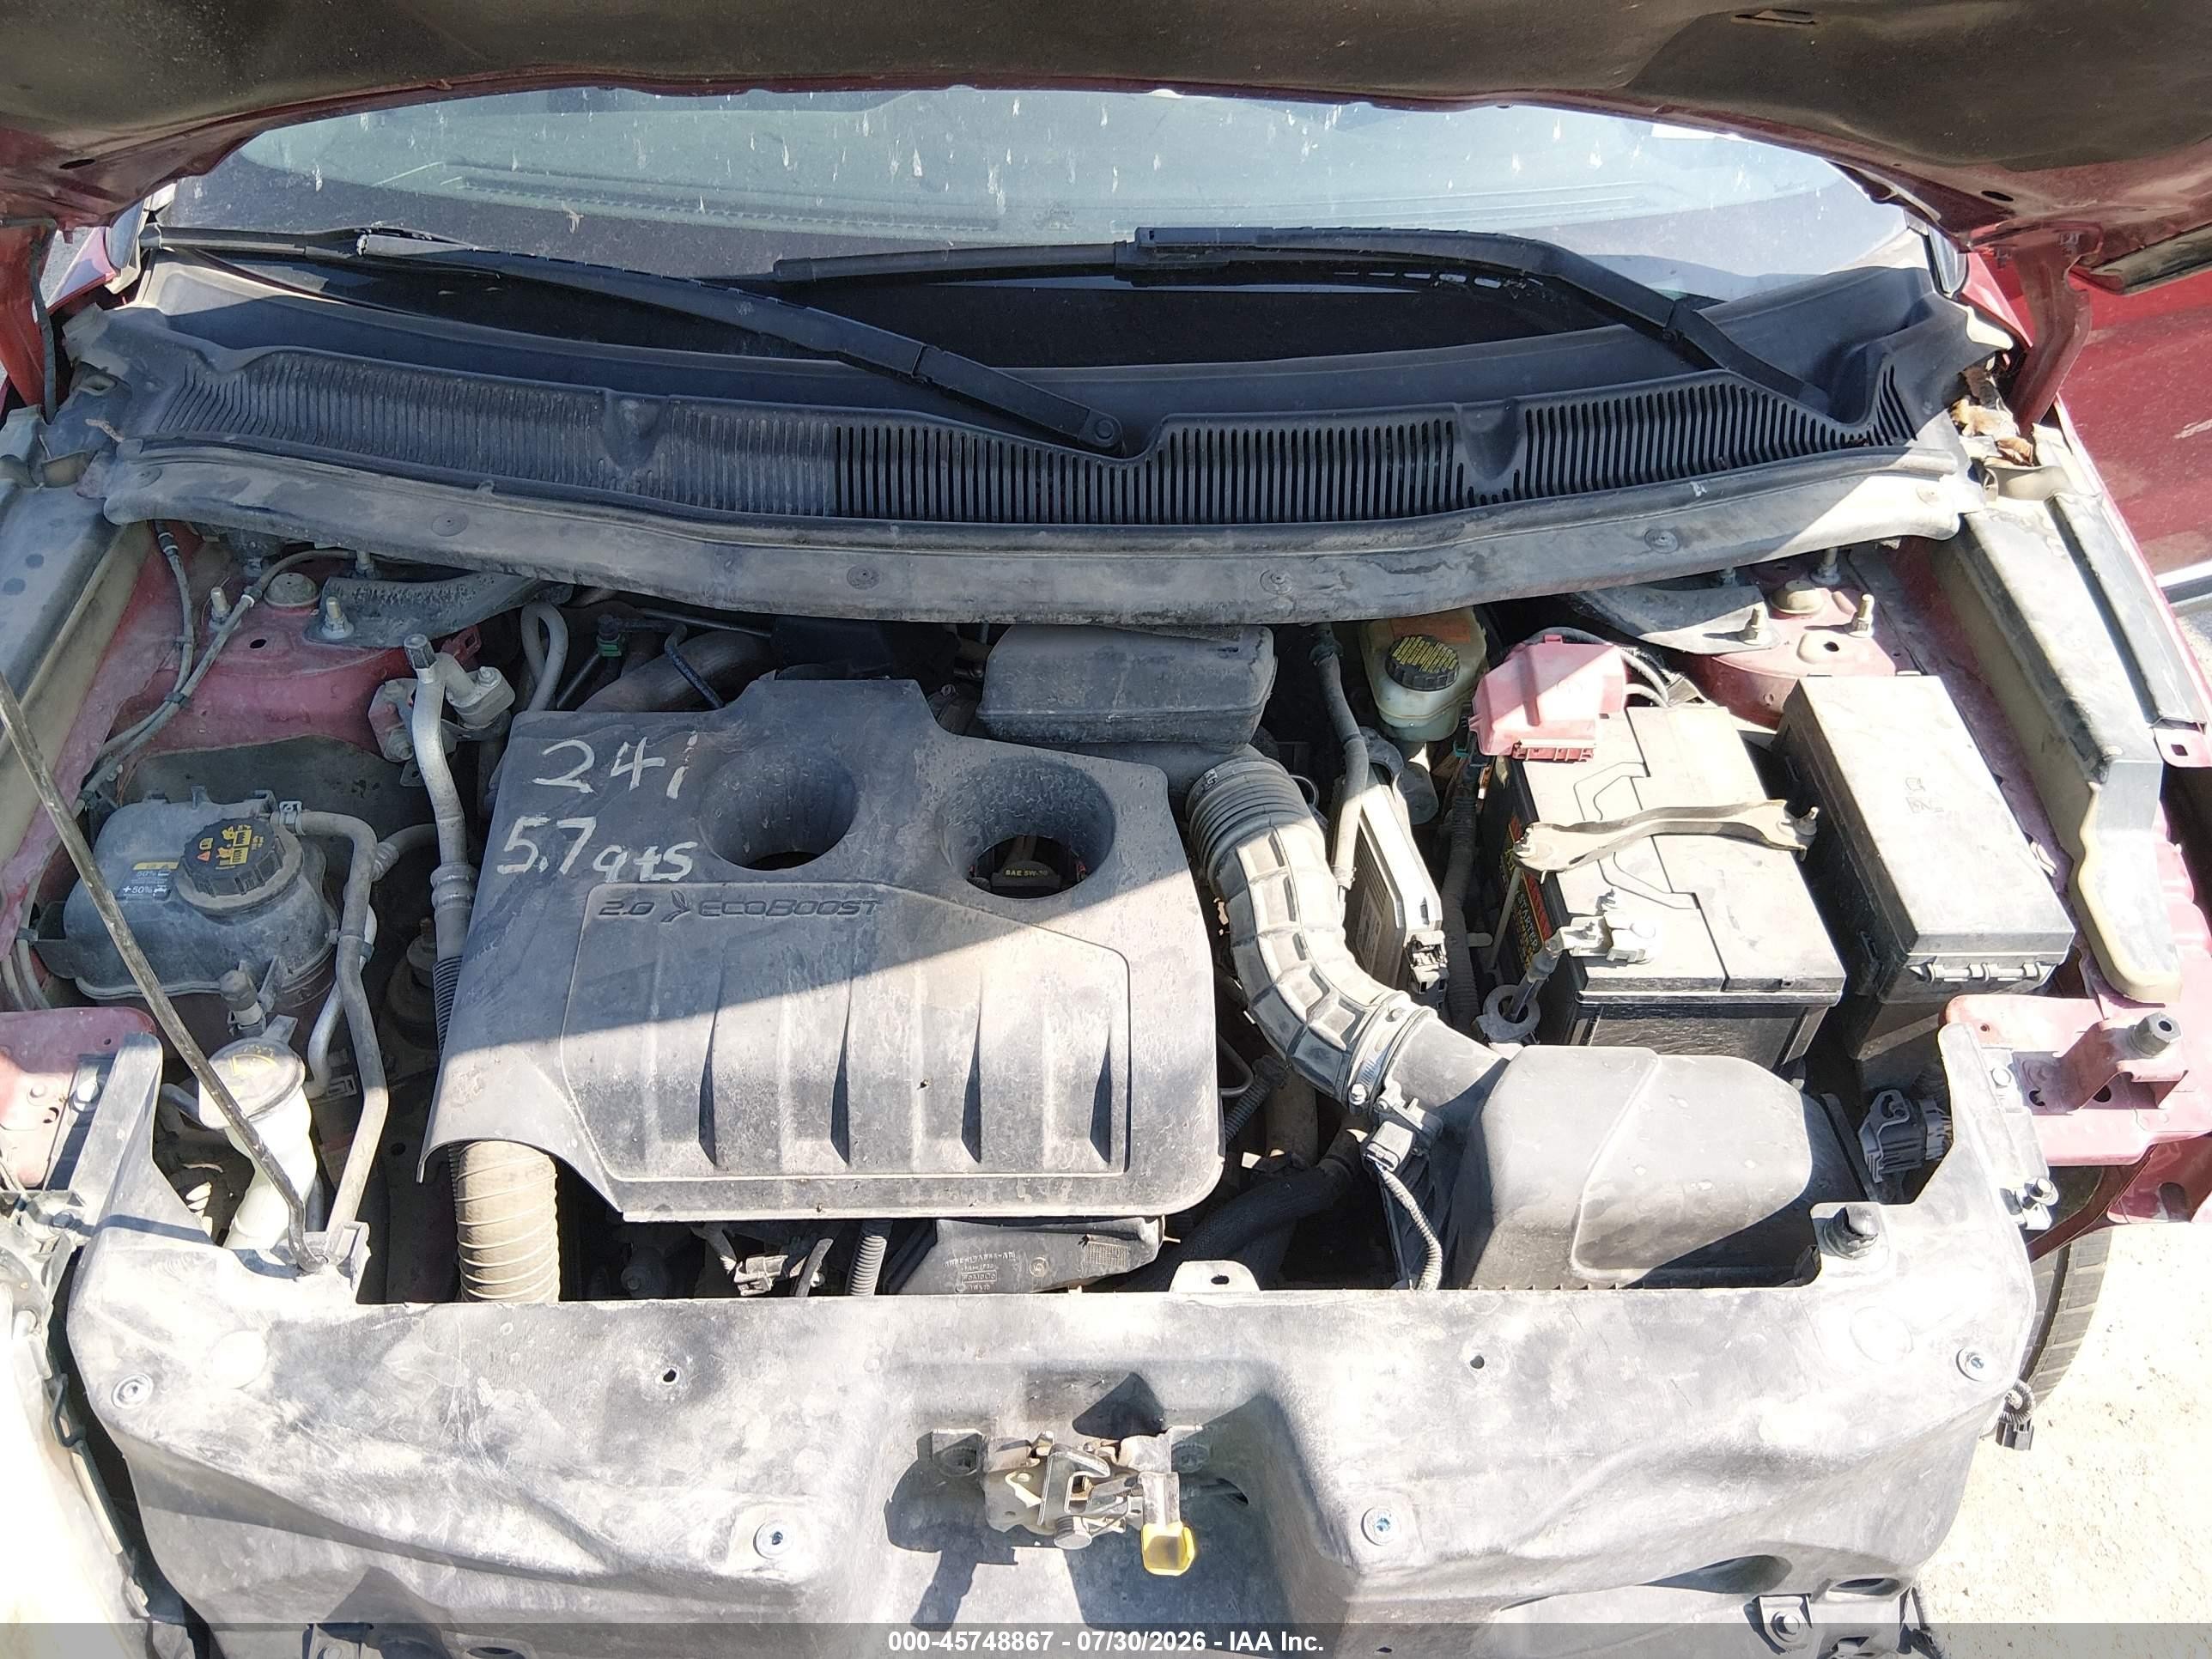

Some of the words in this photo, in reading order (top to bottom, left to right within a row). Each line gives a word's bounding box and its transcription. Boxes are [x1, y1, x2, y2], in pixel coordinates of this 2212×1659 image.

[497, 812, 597, 875] 5.7
[592, 842, 698, 883] qts
[599, 900, 655, 916] 2.0
[1517, 893, 1539, 951] STARTER
